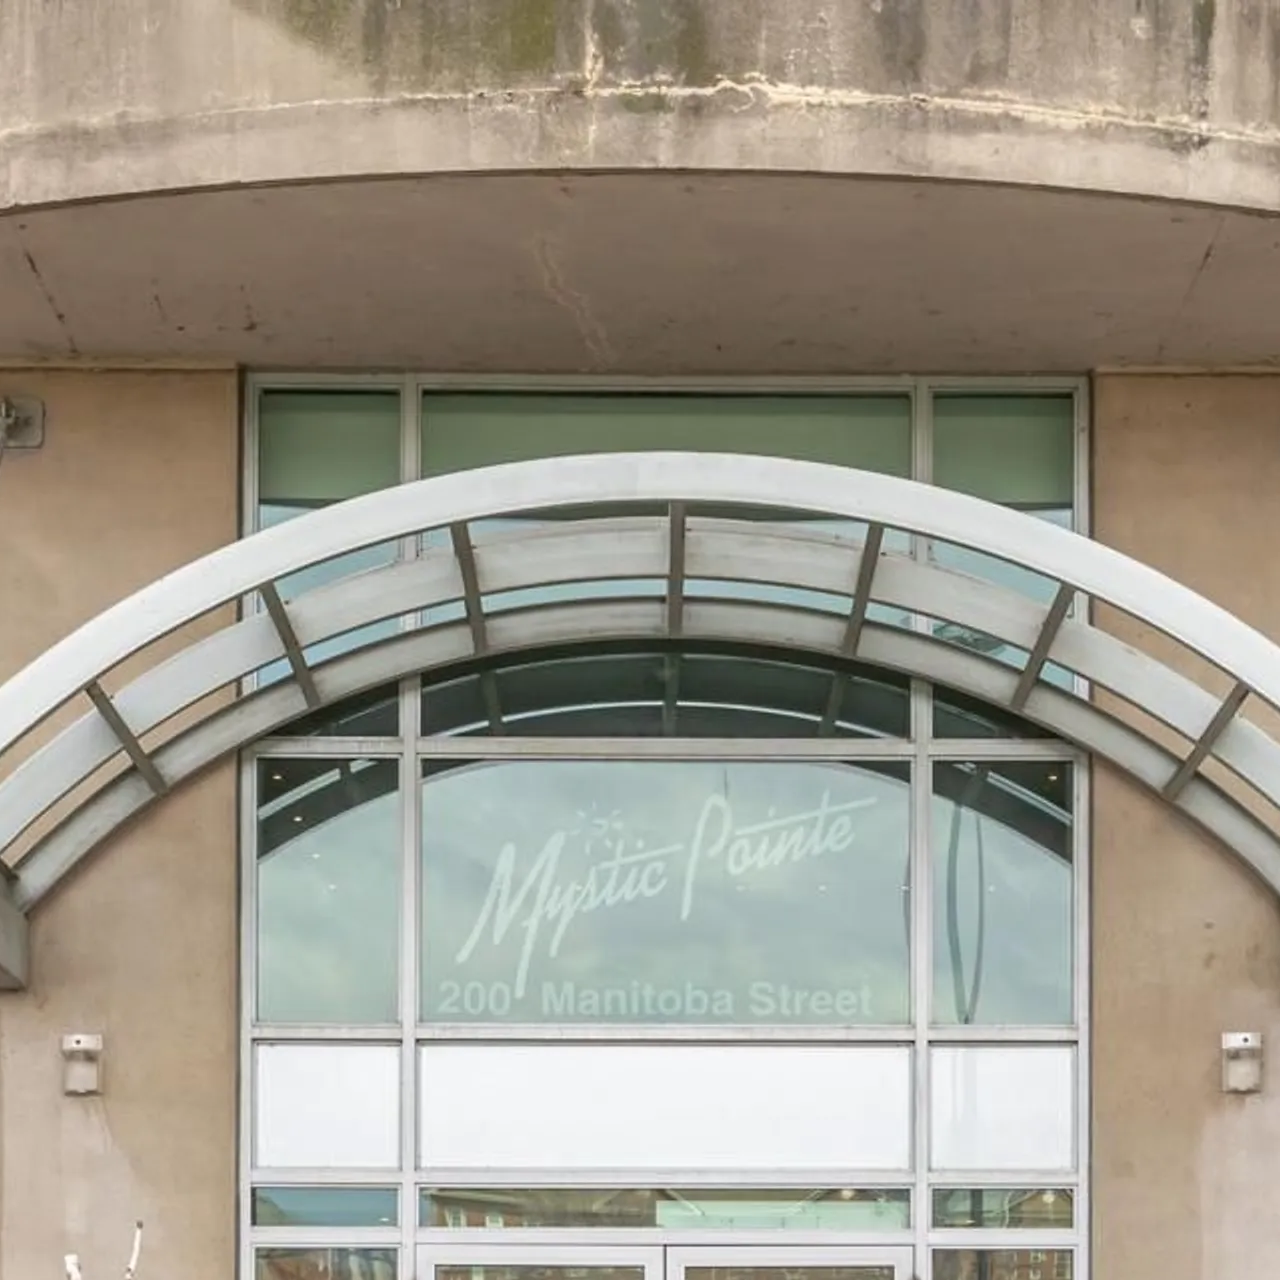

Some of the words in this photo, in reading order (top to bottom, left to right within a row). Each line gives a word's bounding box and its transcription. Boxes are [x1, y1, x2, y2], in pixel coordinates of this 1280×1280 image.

[455, 829, 684, 998] Mystic
[679, 789, 880, 921] Pointe
[437, 980, 511, 1018] 200
[540, 979, 735, 1018] Manitoba
[748, 979, 873, 1018] Street
